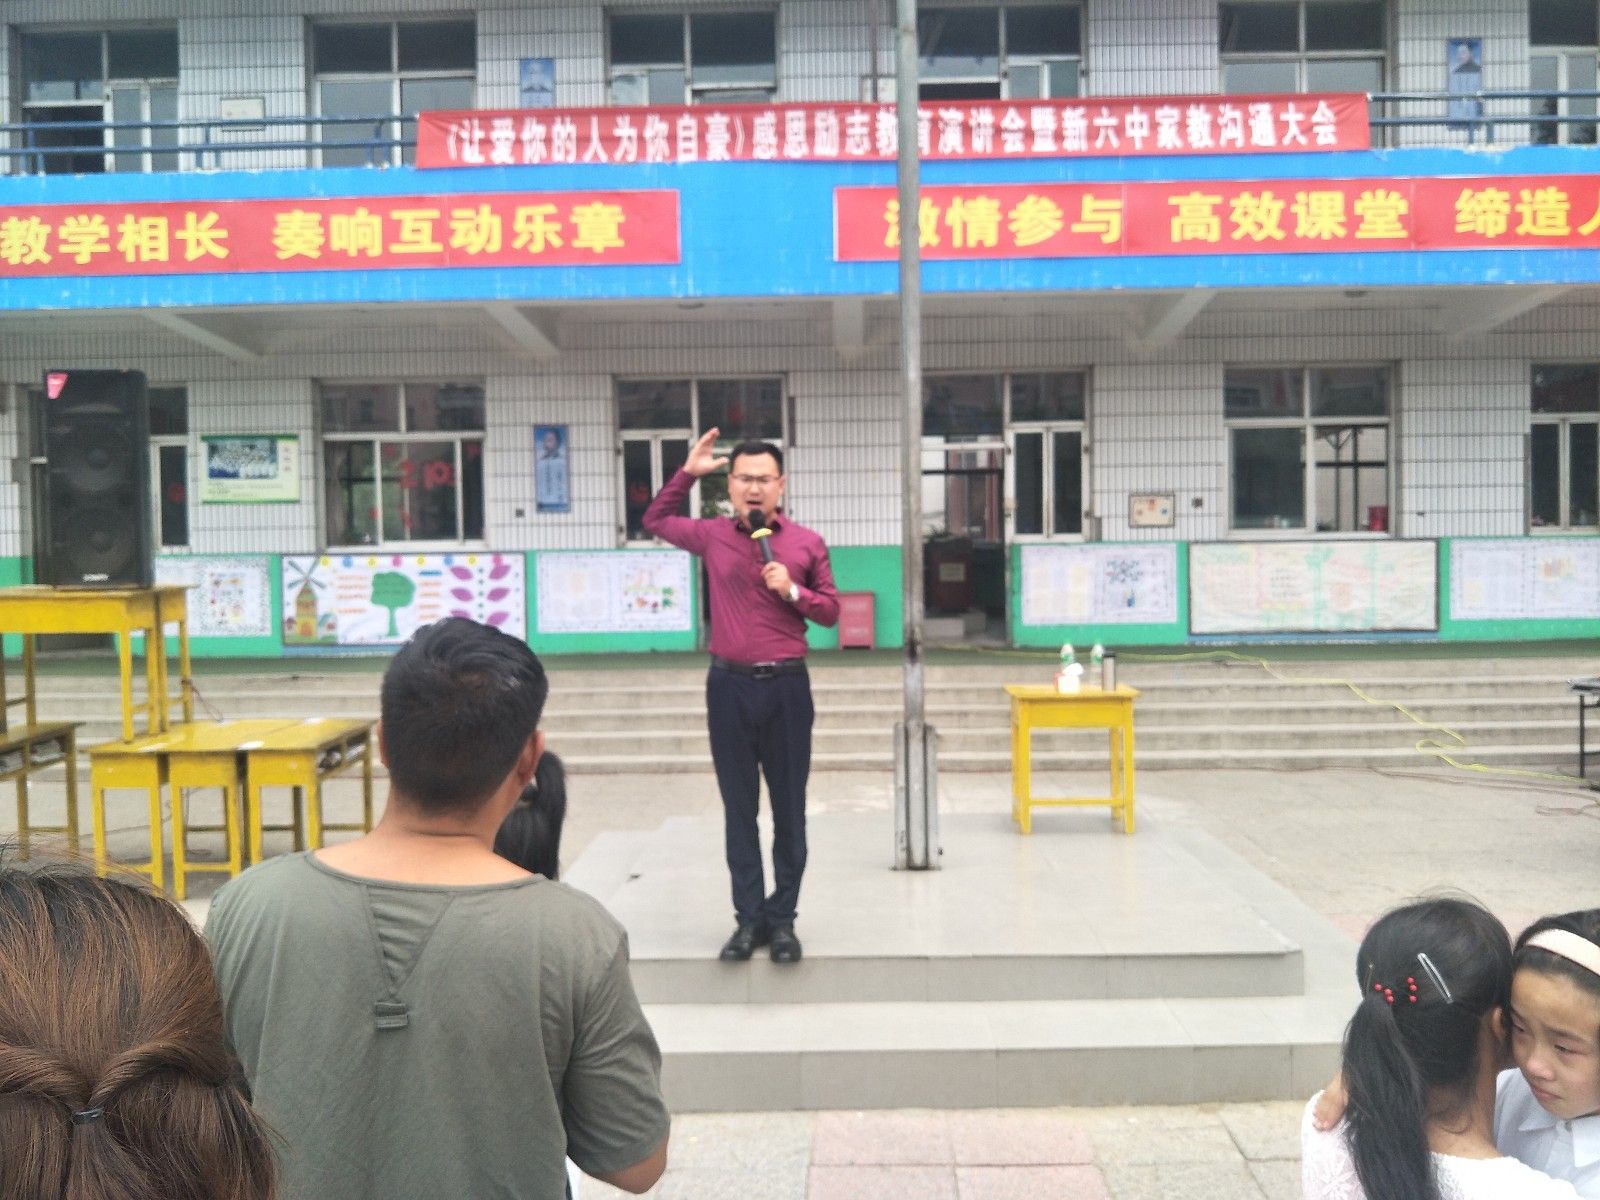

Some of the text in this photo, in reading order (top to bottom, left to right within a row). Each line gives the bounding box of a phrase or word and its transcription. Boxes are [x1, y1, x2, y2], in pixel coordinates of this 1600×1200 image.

[0, 202, 626, 265] 教学相长 奏响互动乐章
[884, 193, 1122, 248] 激情参与
[1168, 189, 1409, 243] 高效课堂
